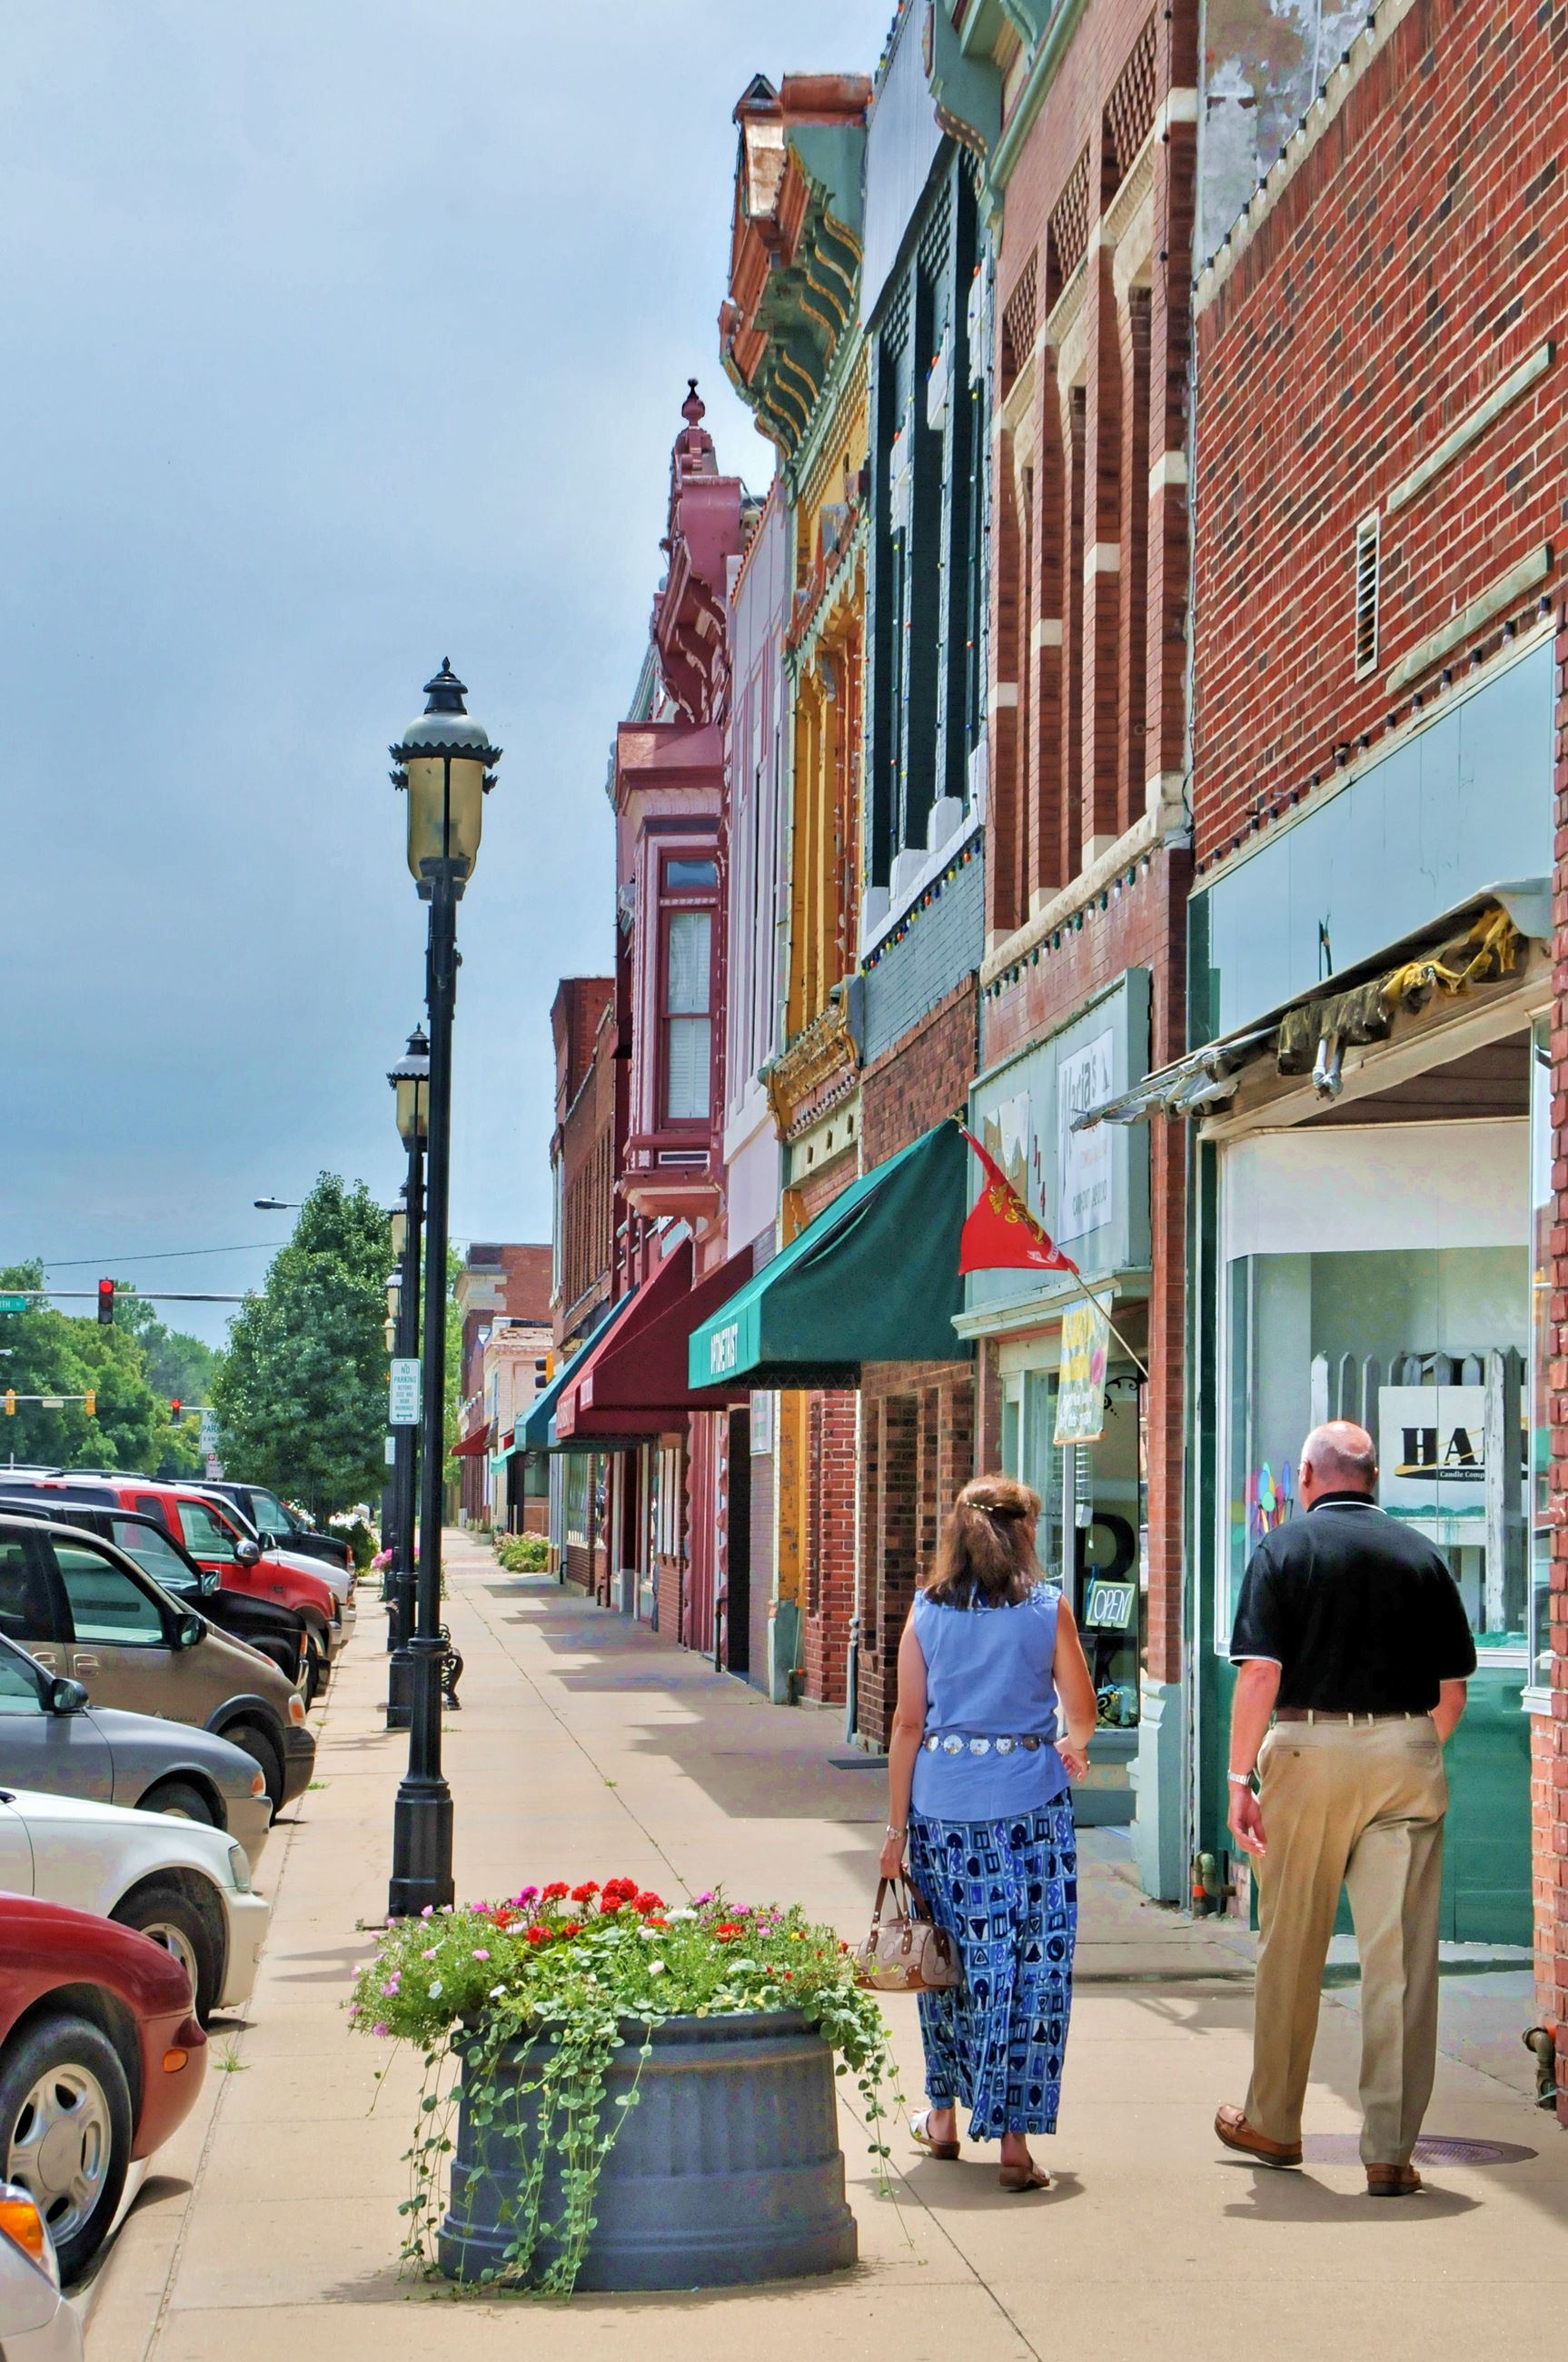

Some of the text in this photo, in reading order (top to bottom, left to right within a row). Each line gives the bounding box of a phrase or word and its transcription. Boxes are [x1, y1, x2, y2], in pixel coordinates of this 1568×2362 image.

[401, 1365, 411, 1375] NO
[393, 1375, 417, 1384] PARKING
[1401, 1427, 1485, 1466] HA
[1439, 1470, 1464, 1479] Candle
[1094, 1589, 1131, 1623] OPEN
